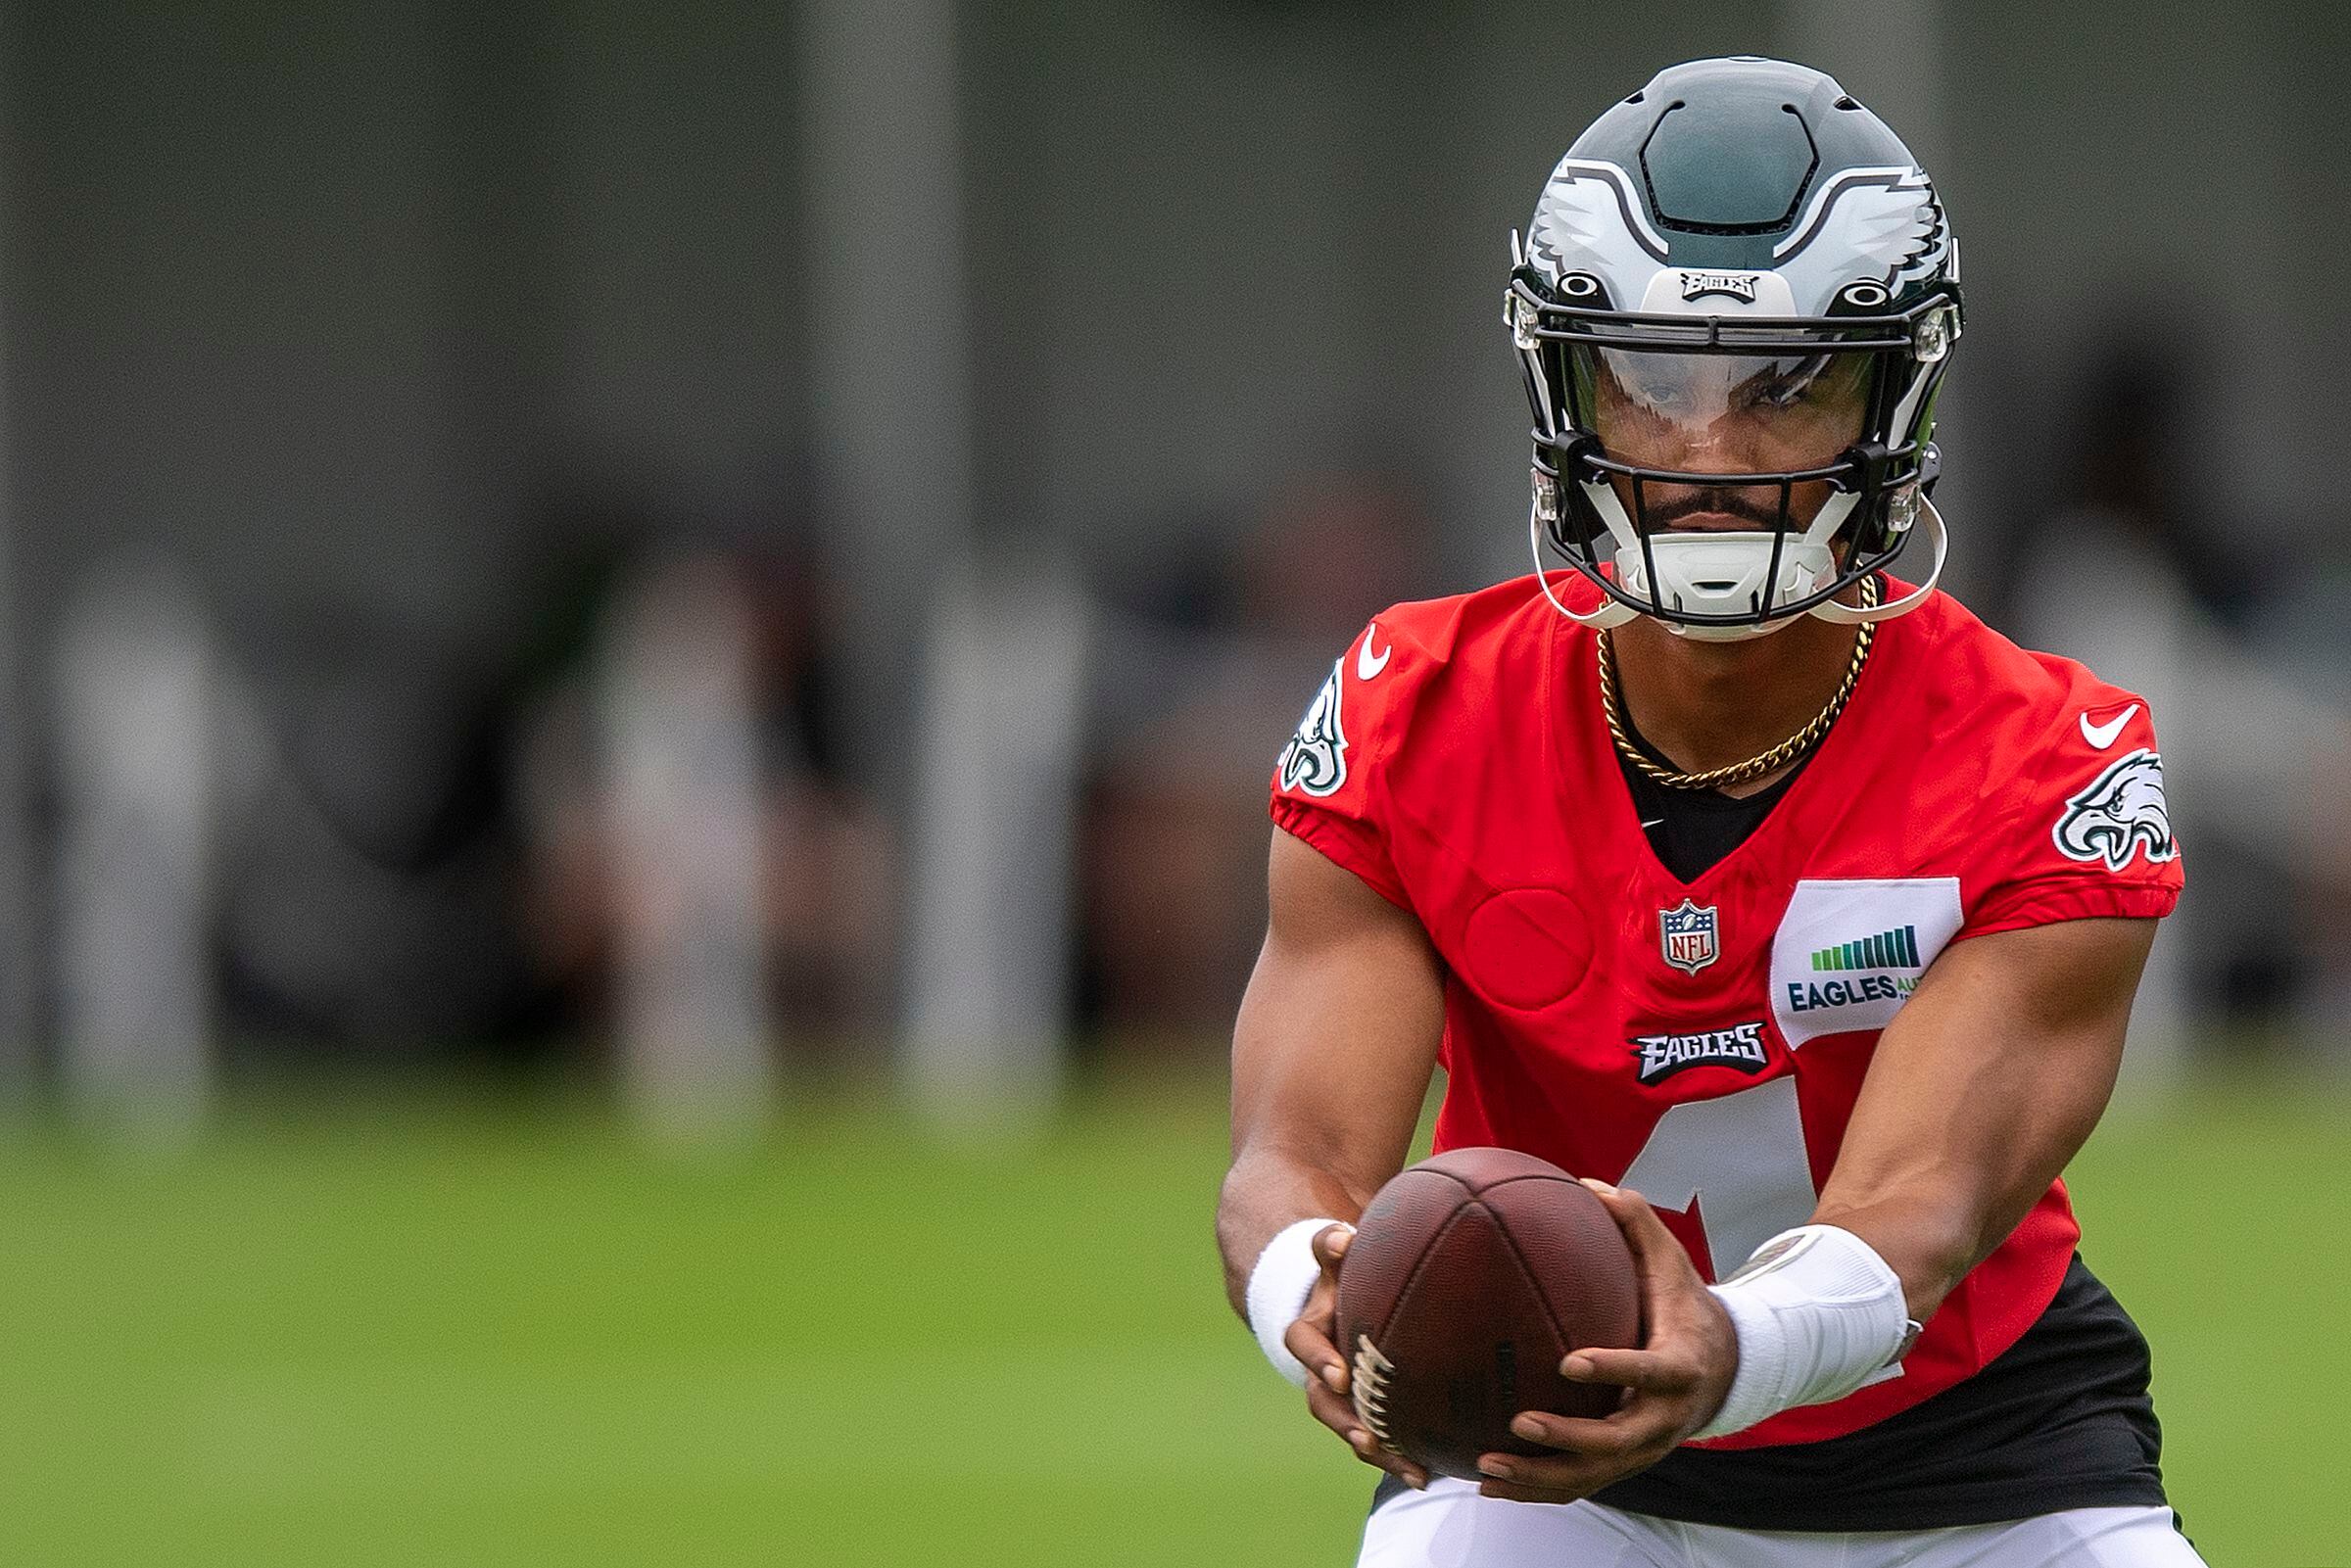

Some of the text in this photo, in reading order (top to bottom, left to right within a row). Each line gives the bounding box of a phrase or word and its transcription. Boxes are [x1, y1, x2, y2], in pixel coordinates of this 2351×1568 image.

[1681, 273, 1759, 305] EAGLES
[1671, 933, 1711, 961] NFL
[1788, 975, 1897, 1013] EAGLES
[1634, 1022, 1768, 1081] EAGLES
